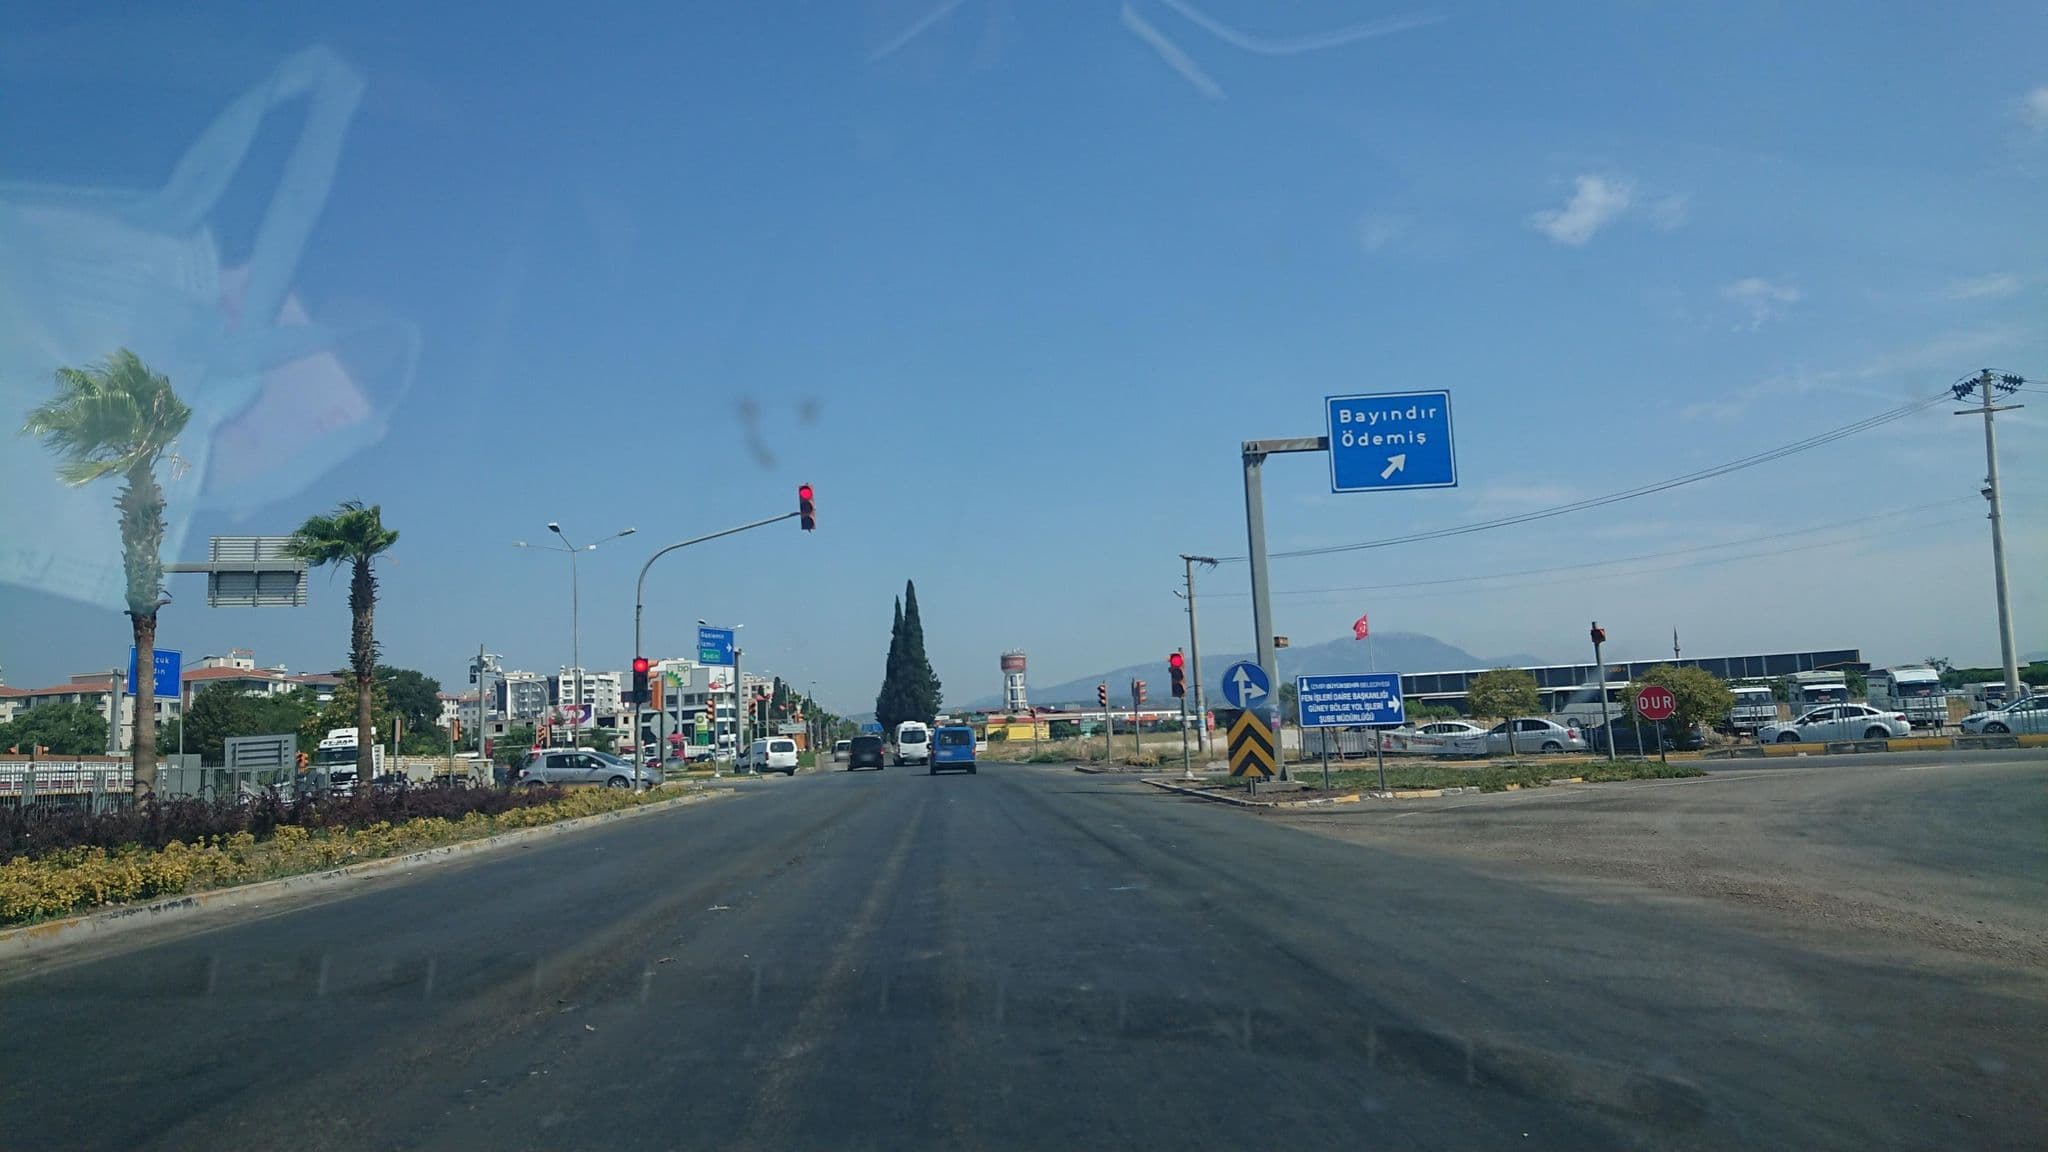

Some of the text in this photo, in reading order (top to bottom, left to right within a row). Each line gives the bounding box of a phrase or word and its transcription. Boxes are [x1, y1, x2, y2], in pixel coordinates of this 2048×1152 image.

[1339, 405, 1437, 426] Bayındır
[1341, 429, 1427, 448] Ödemiş
[678, 665, 689, 674] bp
[1300, 694, 1313, 702] FEN
[1639, 695, 1673, 710] DUR
[1308, 703, 1328, 713] GÜNEY
[1329, 702, 1350, 712] BÖLGE
[1351, 703, 1363, 711] YOL
[1318, 714, 1336, 724] ŞUBE
